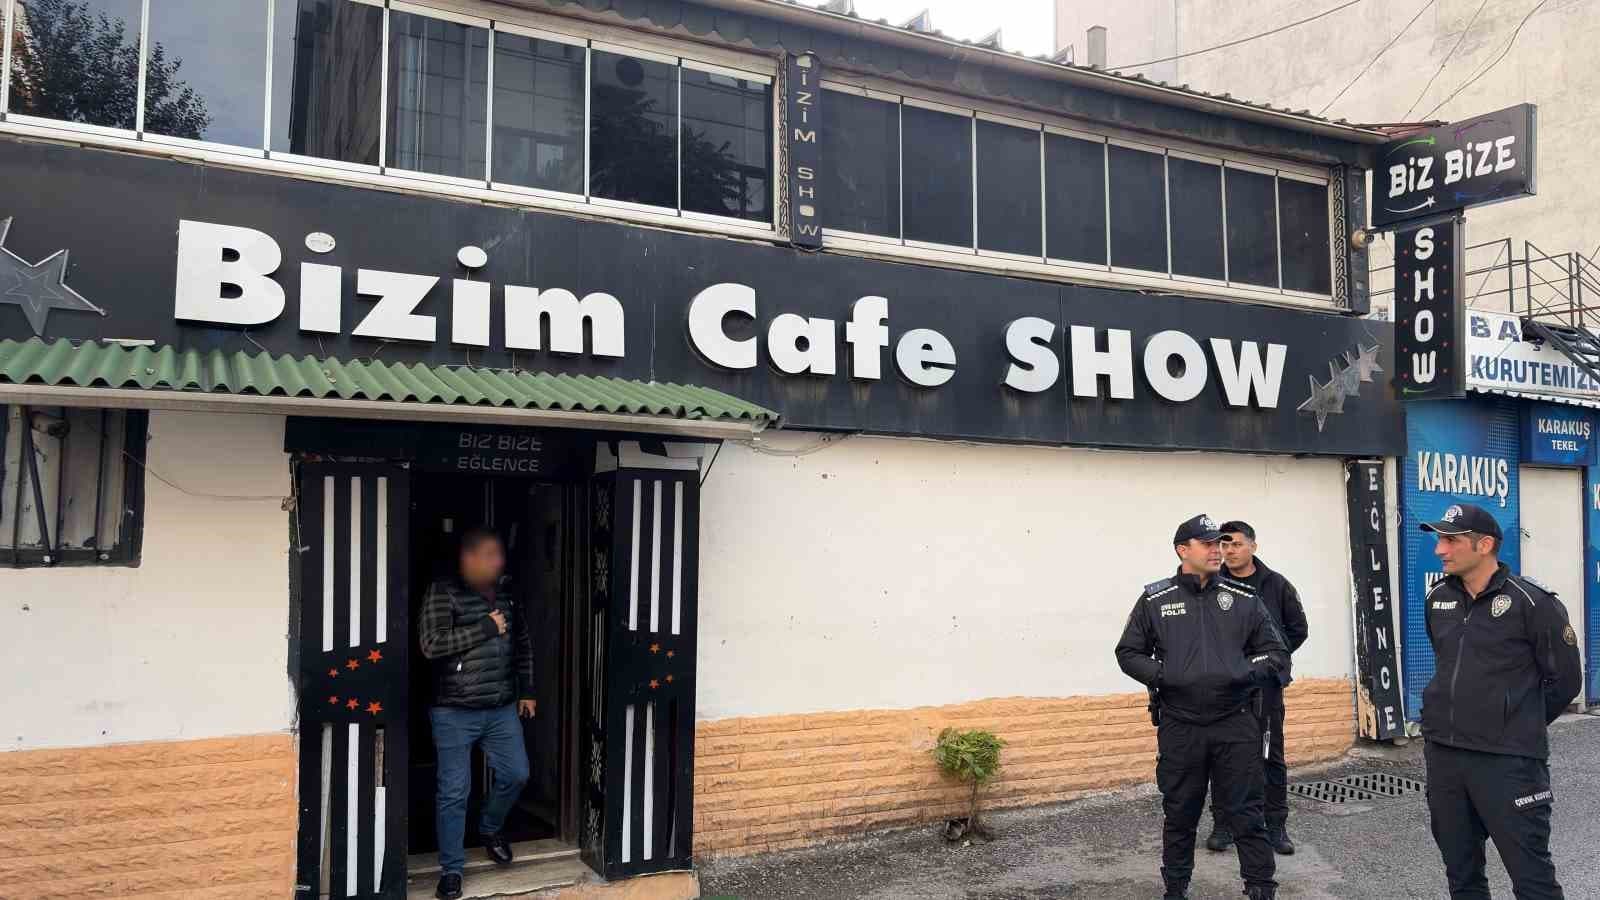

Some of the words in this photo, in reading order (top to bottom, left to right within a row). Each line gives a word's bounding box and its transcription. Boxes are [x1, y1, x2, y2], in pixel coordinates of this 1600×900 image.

[174, 219, 625, 358] Bizim
[687, 282, 958, 388] Cafe
[1004, 316, 1288, 410] SHOW
[1412, 227, 1436, 384] SHOW
[1538, 418, 1591, 440] KARAKUŞ
[1552, 439, 1579, 451] TEKEL
[1418, 450, 1509, 507] KARAKUŞ
